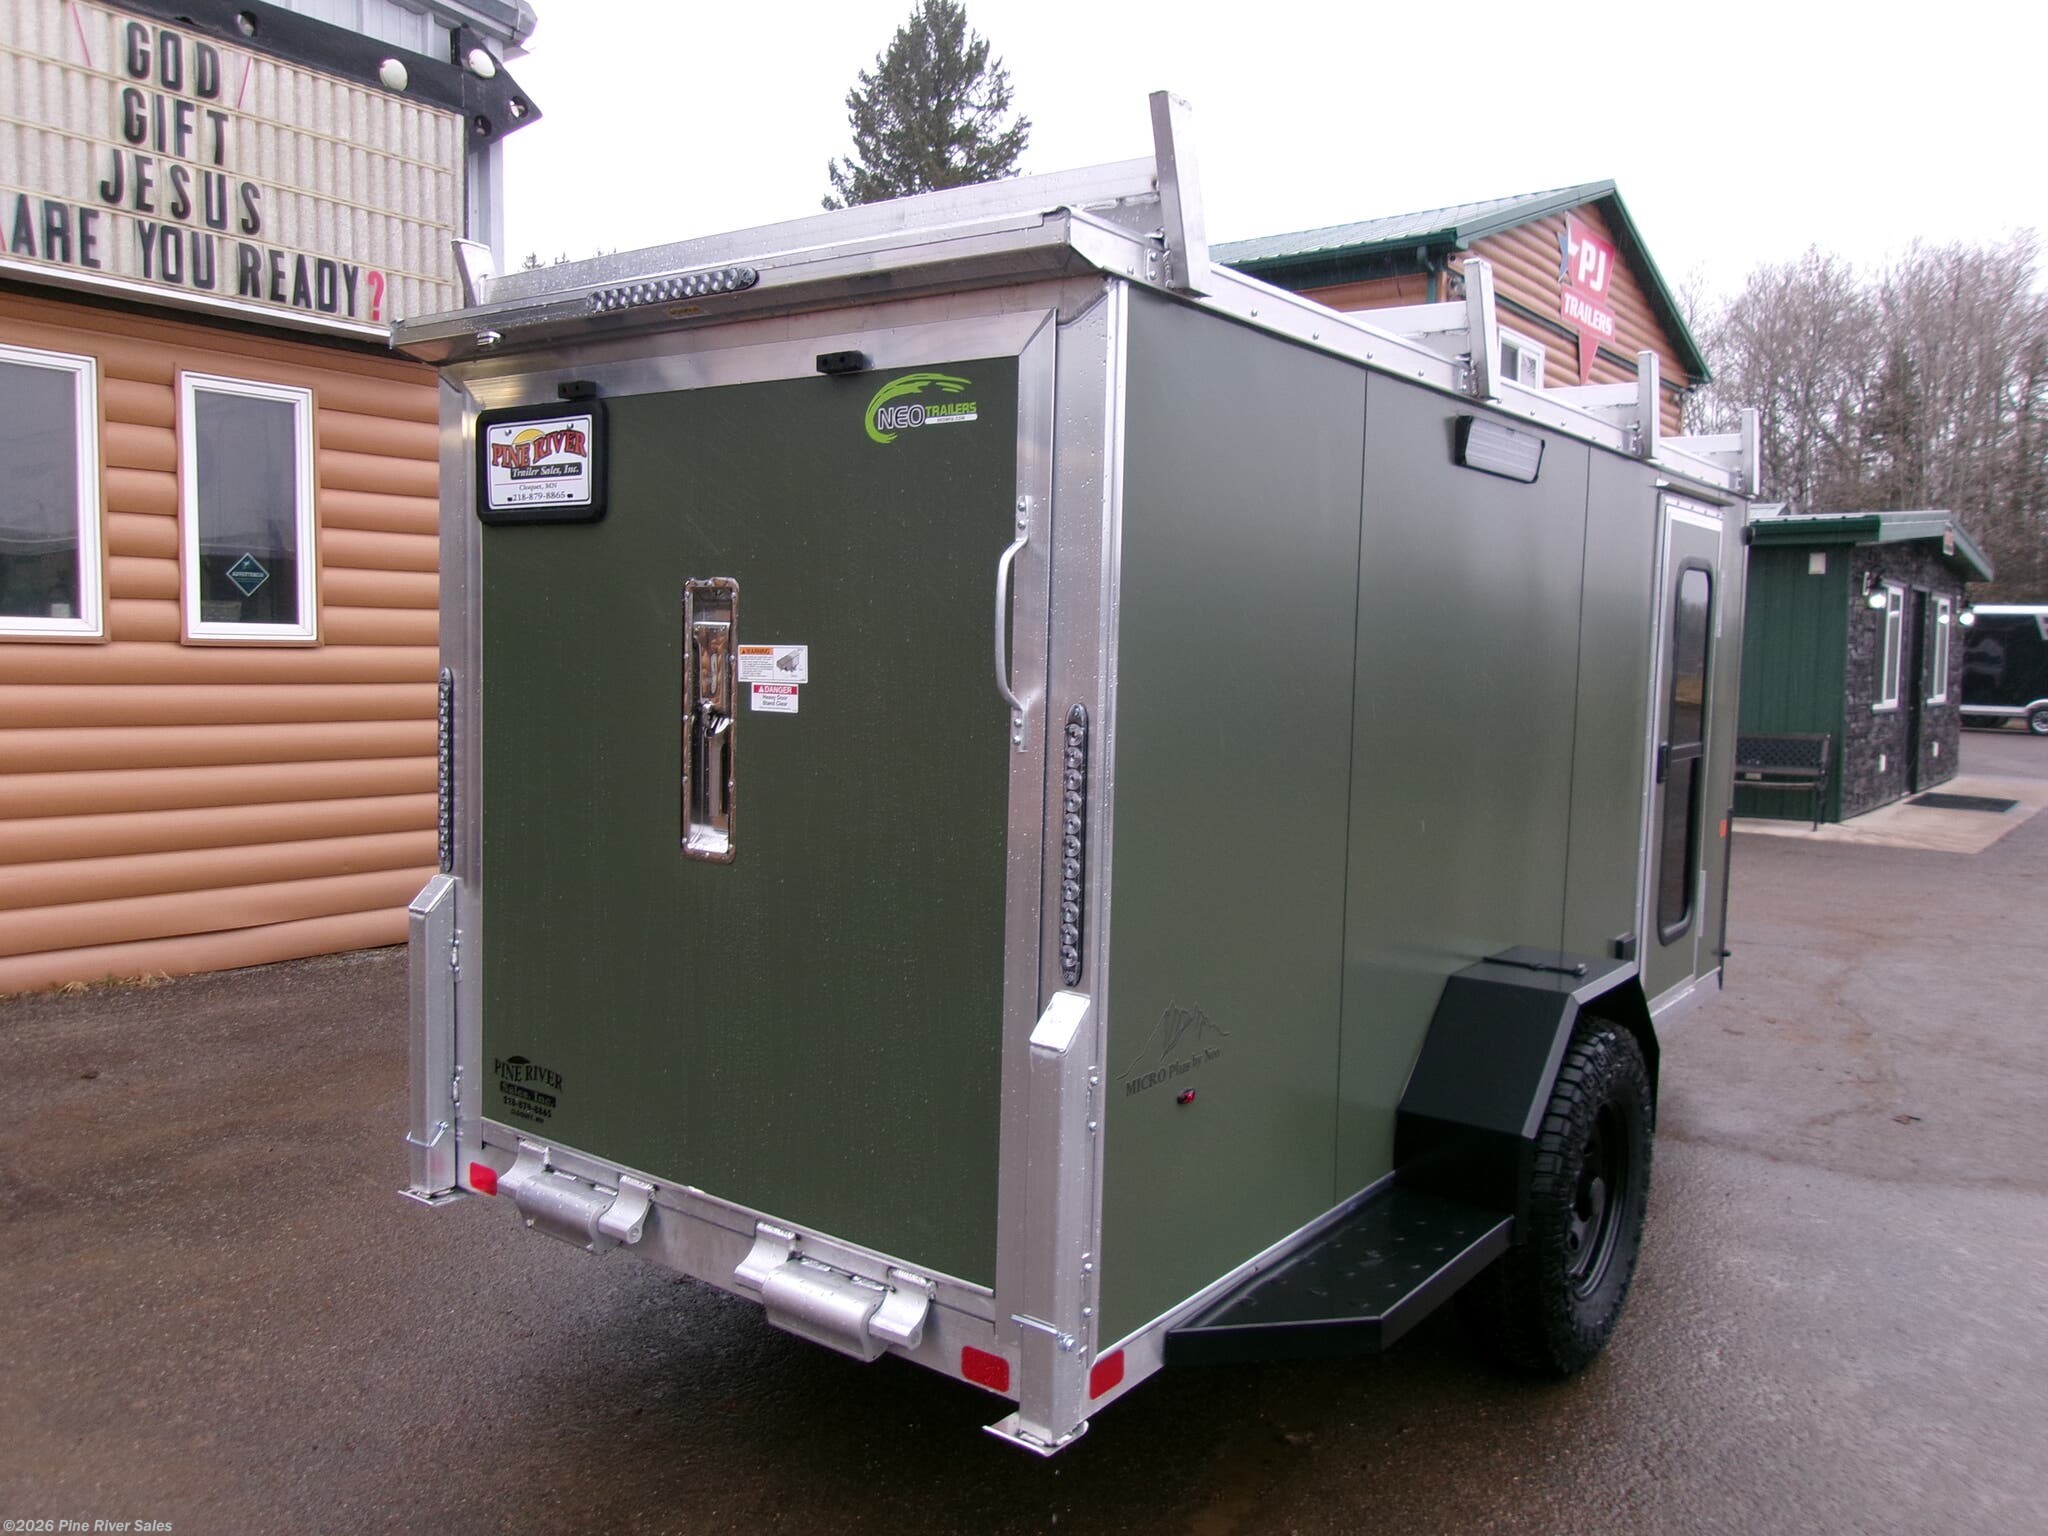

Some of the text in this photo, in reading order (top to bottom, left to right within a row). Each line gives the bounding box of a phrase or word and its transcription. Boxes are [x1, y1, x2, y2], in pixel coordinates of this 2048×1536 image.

[126, 21, 221, 99] GOD
[122, 87, 229, 166] GIFT
[100, 149, 262, 235] JESUS
[12, 193, 386, 322] ARE YOU READY?
[1577, 239, 1607, 292] PJ
[1564, 291, 1613, 337] TRAILERS
[877, 402, 977, 430] NEO TRAILERS
[491, 429, 588, 469] PINE RIVER
[512, 466, 539, 478] Trailer
[563, 464, 580, 474] Inc.
[764, 686, 793, 694] DANGER
[494, 1058, 563, 1093] PINE RIVER
[1126, 1068, 1167, 1097] MICRO
[1191, 1053, 1202, 1068] by
